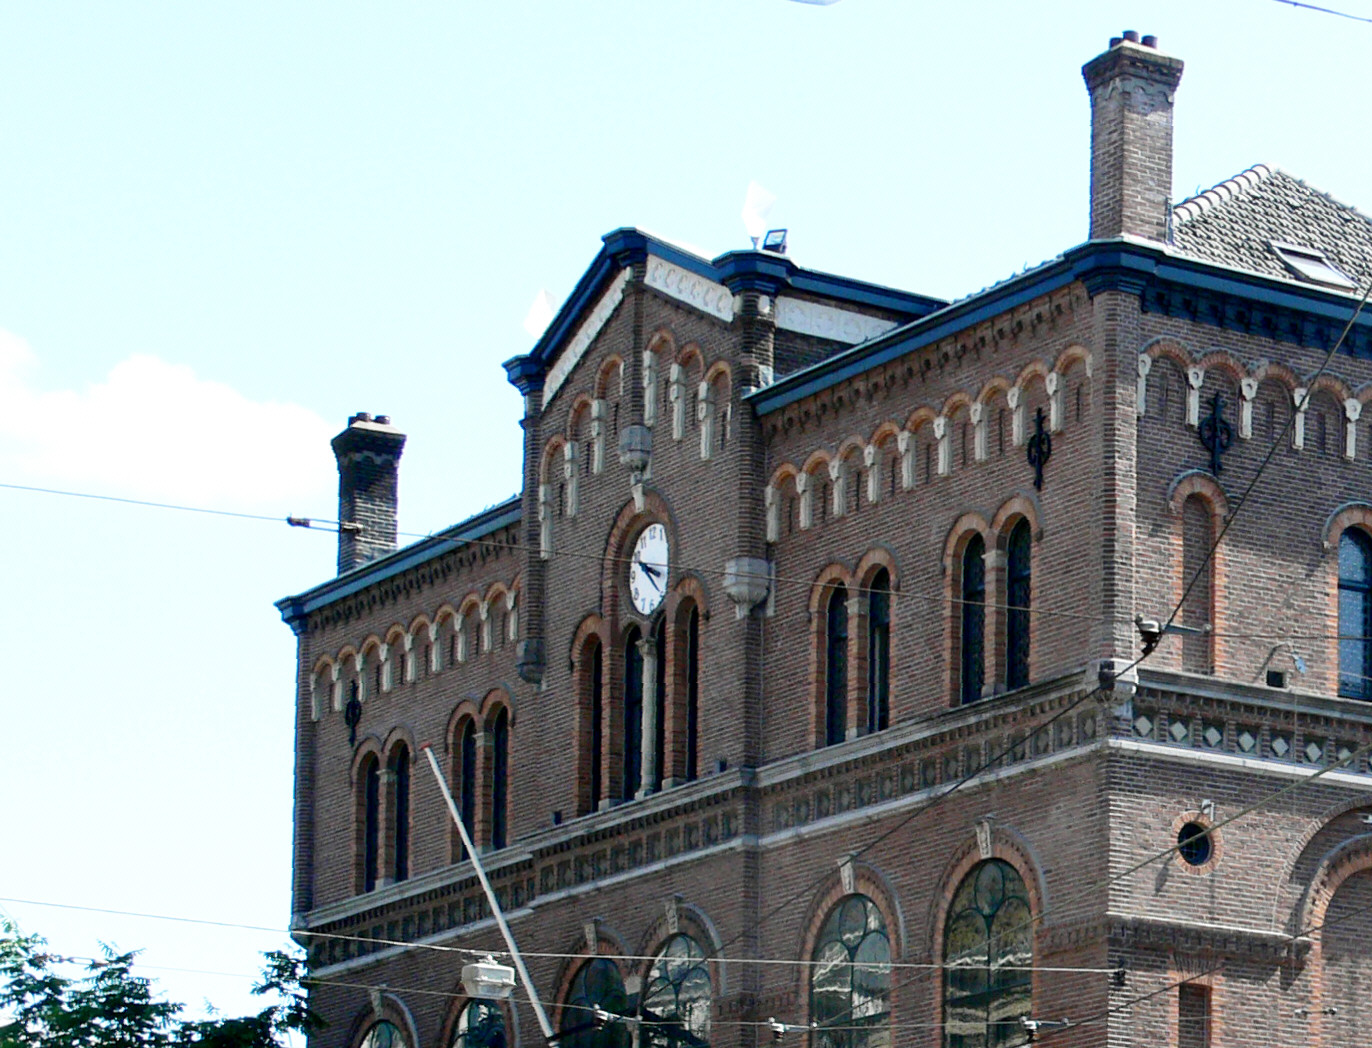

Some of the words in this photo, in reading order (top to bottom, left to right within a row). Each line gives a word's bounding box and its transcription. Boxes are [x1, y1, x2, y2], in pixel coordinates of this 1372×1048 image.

[648, 526, 657, 541] 12
[640, 535, 647, 550] 11
[641, 597, 646, 611] 7
